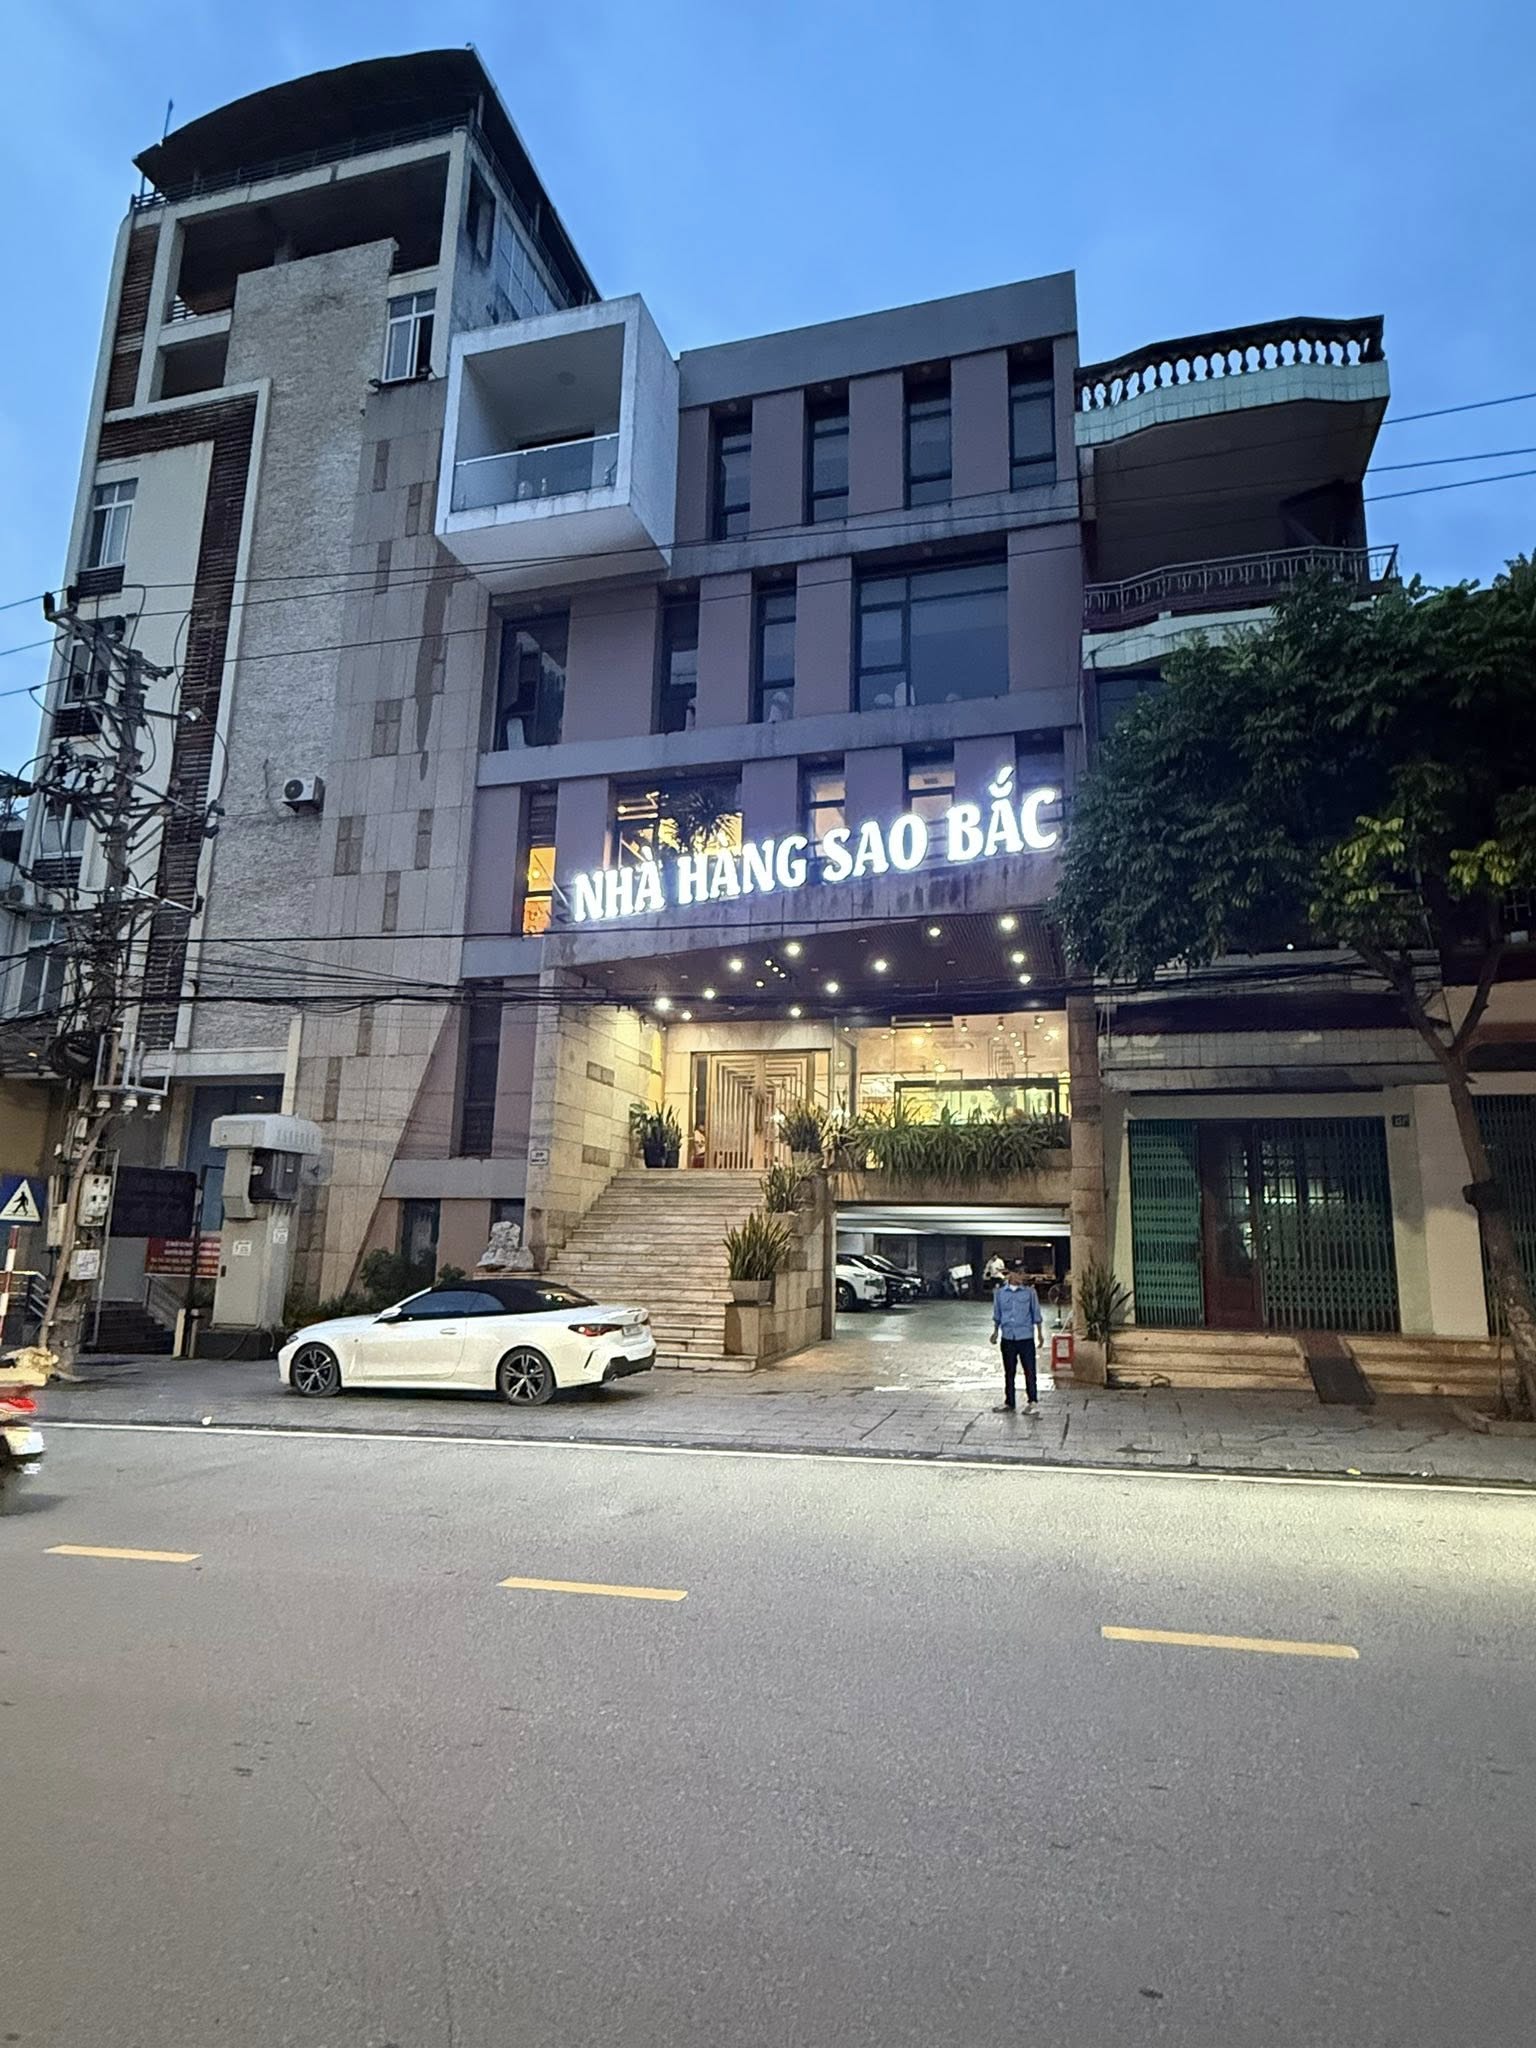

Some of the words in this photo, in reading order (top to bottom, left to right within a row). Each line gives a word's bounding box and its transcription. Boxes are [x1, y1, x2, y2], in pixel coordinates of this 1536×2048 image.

[573, 845, 665, 922] NHÀ
[677, 832, 808, 905] HÀNG
[822, 813, 928, 883] SAO
[945, 766, 1058, 863] BẮC
